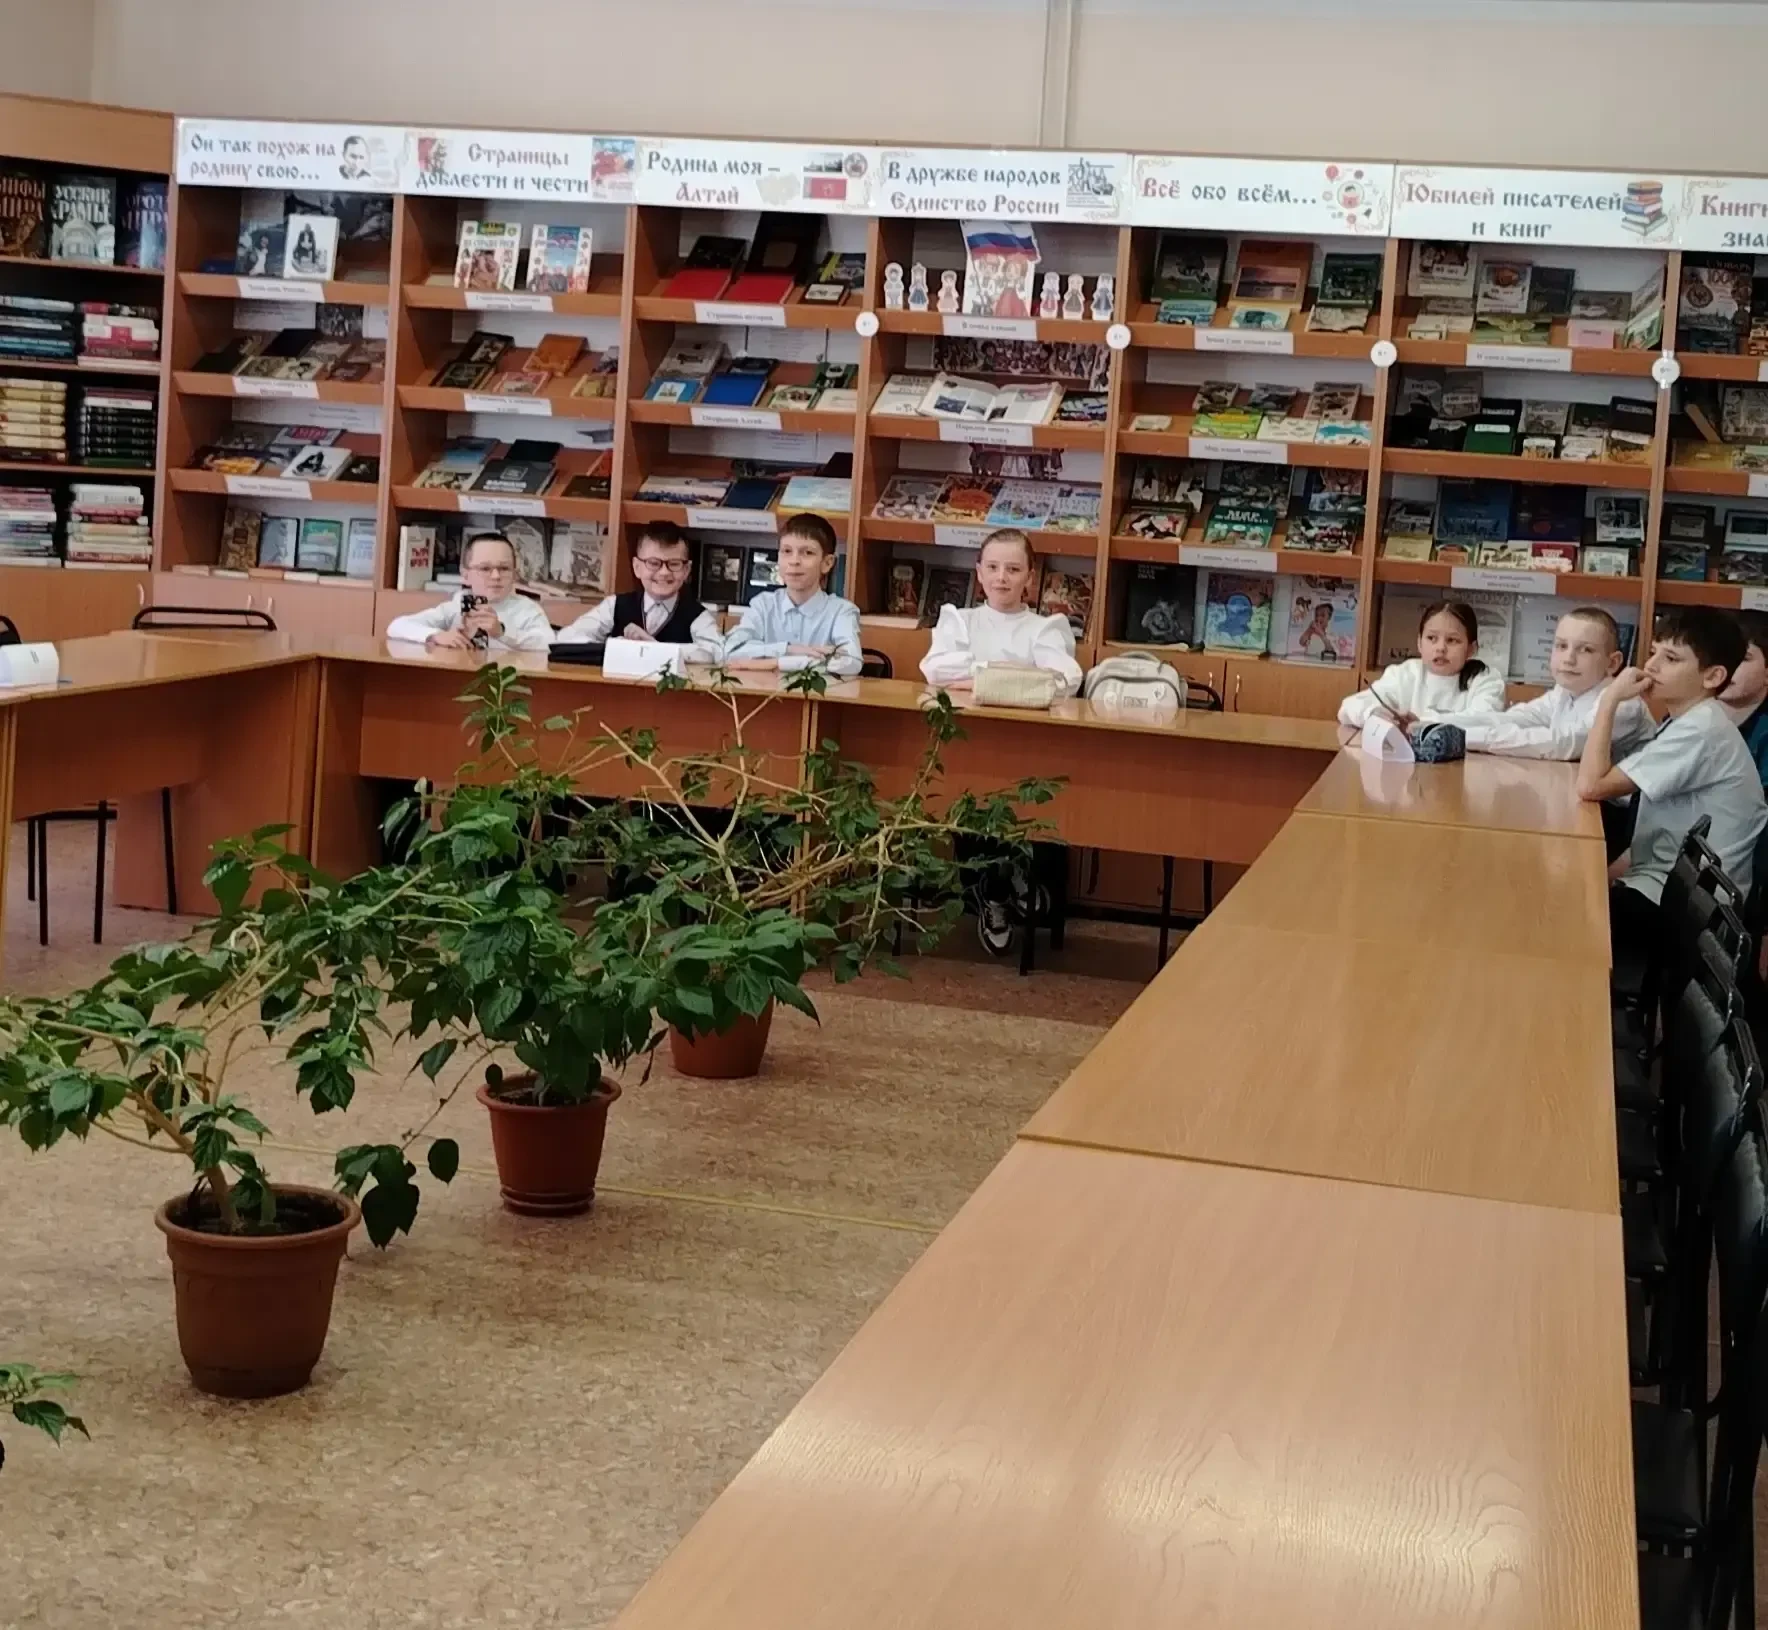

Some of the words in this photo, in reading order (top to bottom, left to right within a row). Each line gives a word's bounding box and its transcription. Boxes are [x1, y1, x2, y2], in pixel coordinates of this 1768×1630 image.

[191, 132, 213, 150] Он
[219, 138, 252, 153] так
[257, 140, 311, 160] похож
[316, 143, 337, 157] на
[468, 143, 569, 168] Страницы
[190, 161, 252, 181] родину
[257, 164, 321, 181] свою...
[647, 150, 718, 175] Родина
[723, 159, 763, 176] моя
[887, 161, 901, 180] В
[906, 165, 978, 188] дружбе
[983, 166, 1061, 188] народов
[514, 176, 525, 190] и
[532, 176, 589, 194] чести
[676, 181, 739, 205] Алтай
[1142, 177, 1181, 199] Всё
[1191, 184, 1227, 201] обо
[1238, 184, 1318, 205] всём...
[1406, 181, 1495, 207] Юбилей
[1503, 189, 1622, 212] писателей
[891, 191, 987, 213] Единство
[993, 194, 1060, 215] России
[1472, 221, 1486, 236] и
[1499, 222, 1553, 239] книг
[1721, 231, 1768, 248] зна
